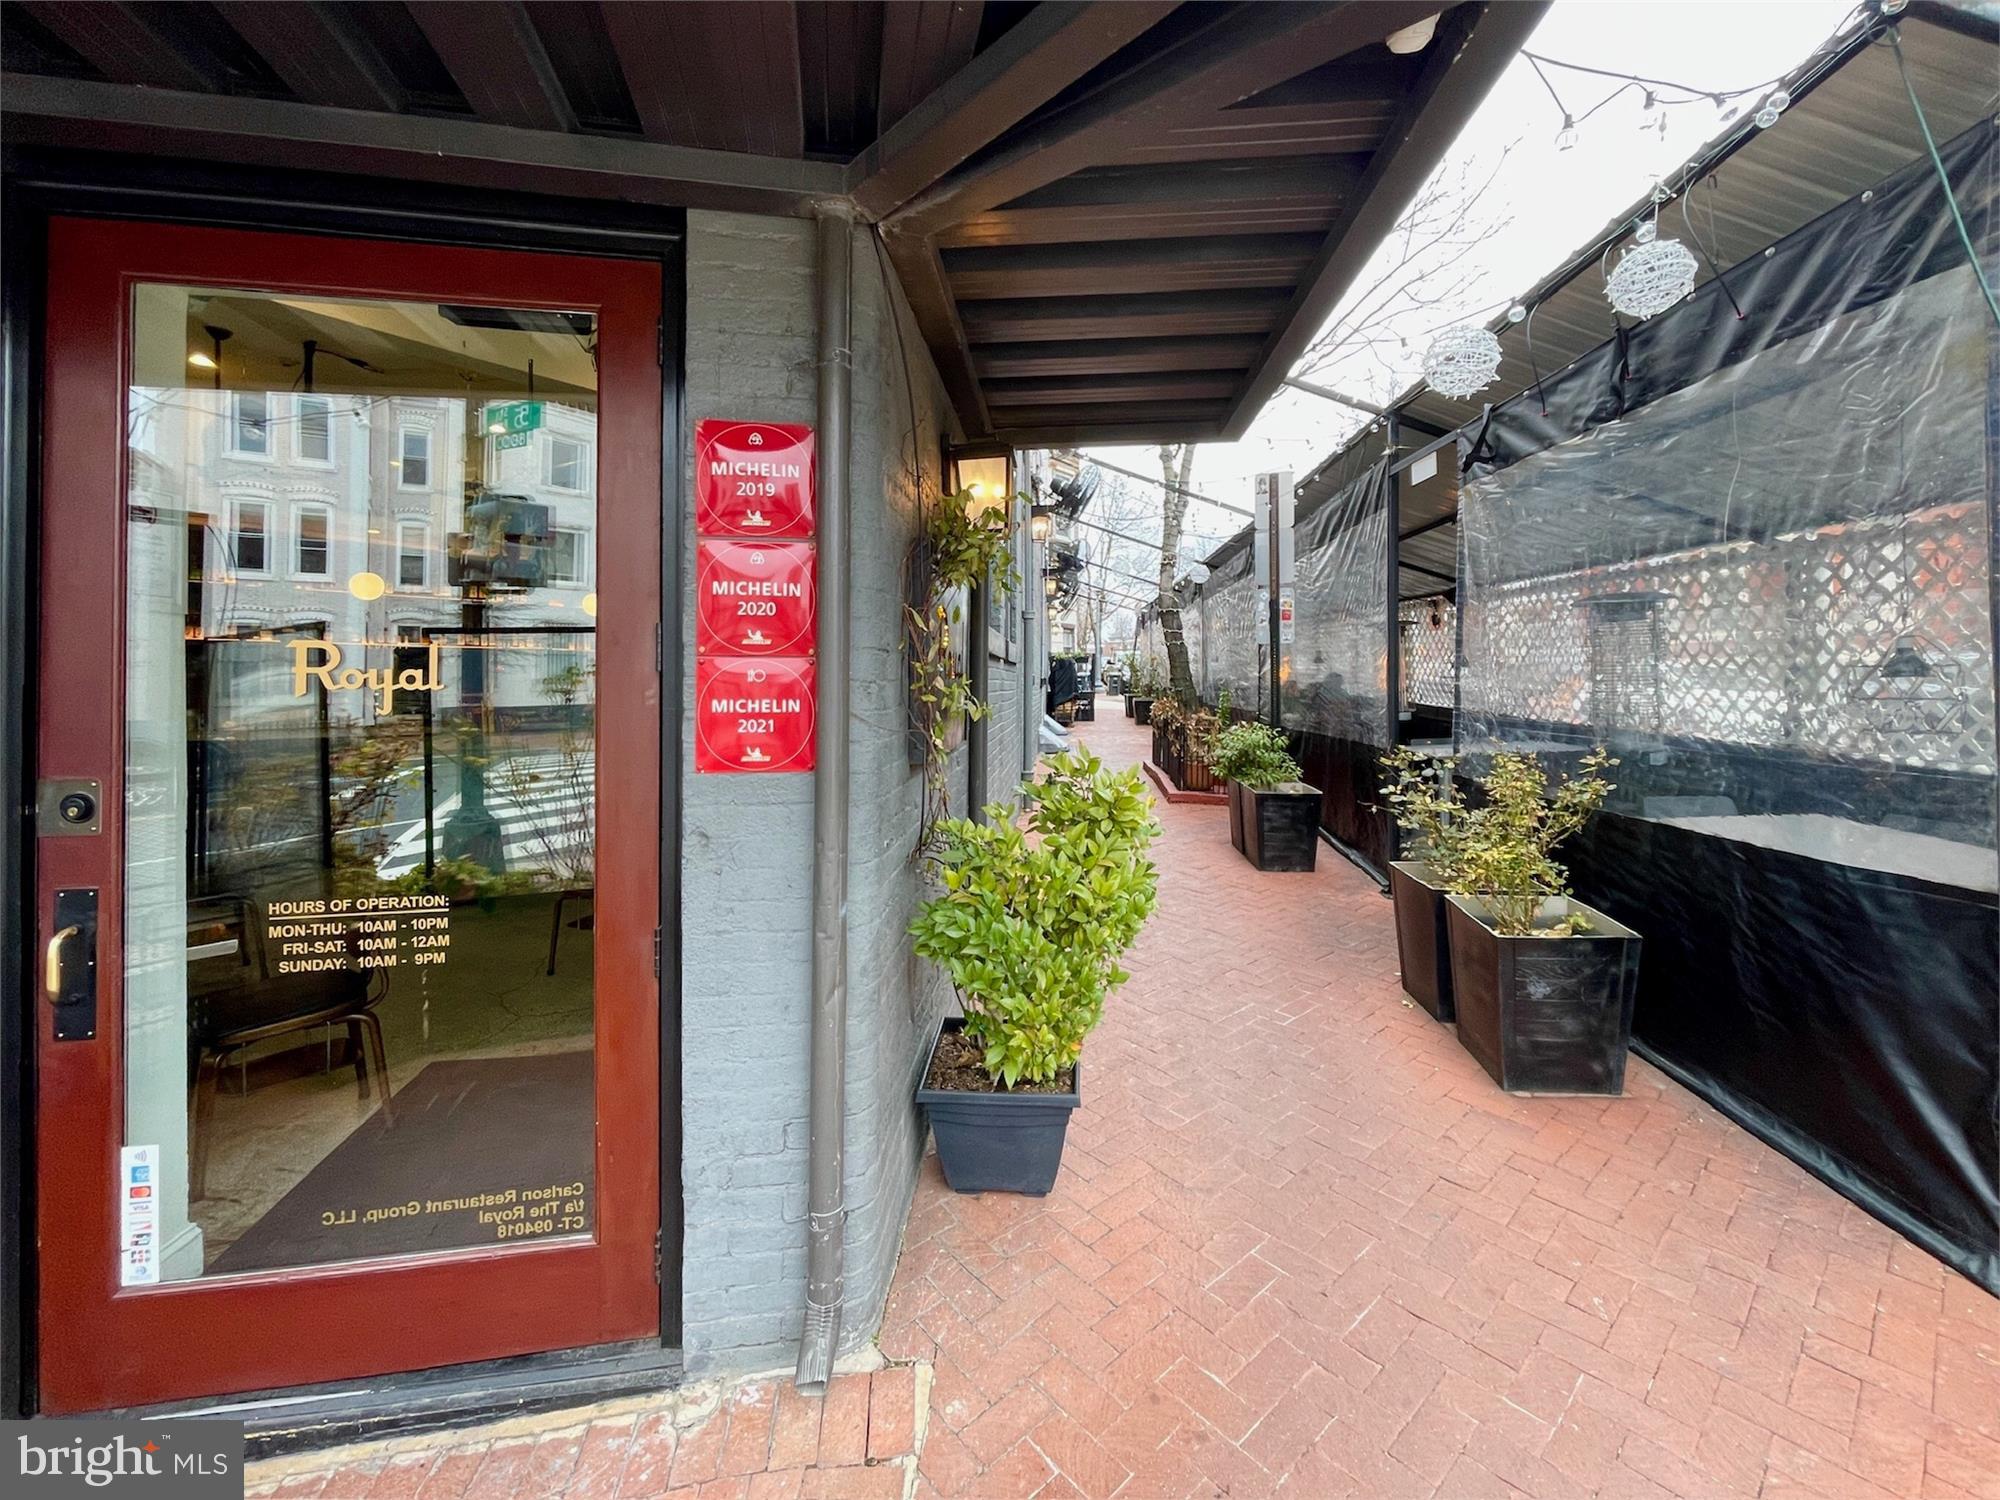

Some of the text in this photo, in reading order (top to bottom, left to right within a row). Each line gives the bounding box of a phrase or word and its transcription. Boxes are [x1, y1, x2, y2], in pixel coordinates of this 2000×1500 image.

[711, 461, 800, 478] MICHELIN
[736, 482, 775, 497] 2019
[712, 581, 801, 597] MICHELIN
[737, 601, 777, 616] 2020
[285, 638, 446, 716] Royal
[711, 699, 801, 713] MICHELIN
[737, 719, 774, 733] 2021
[268, 895, 449, 915] HOURS OF OPERATION:
[268, 922, 347, 938] MON-THU:
[357, 920, 397, 933] 10AM
[410, 917, 449, 930] 10PM
[283, 940, 347, 955] FRI-SAT:
[357, 937, 397, 951] 10AM
[411, 935, 450, 948] 12AM
[278, 958, 347, 973] SUNDAY:
[357, 955, 397, 968] 10AM
[414, 952, 446, 965] 9PM
